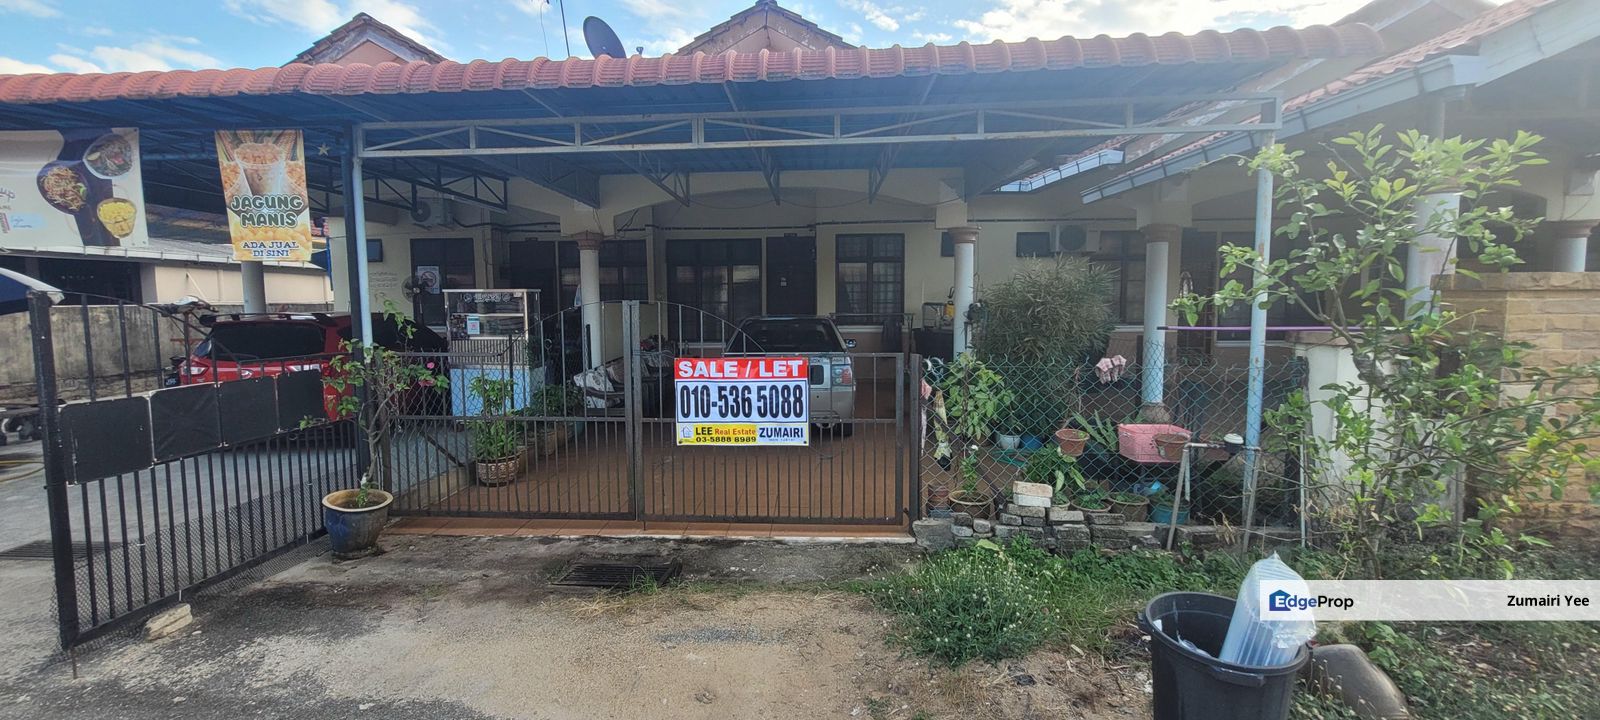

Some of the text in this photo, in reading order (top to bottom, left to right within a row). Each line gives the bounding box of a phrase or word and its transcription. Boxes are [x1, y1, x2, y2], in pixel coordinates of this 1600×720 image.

[231, 195, 303, 210] JAGUNG
[241, 212, 298, 228] MANIS
[678, 360, 803, 378] SALE / LET
[680, 384, 804, 419] 010-536 5088
[695, 427, 713, 436] LEE
[714, 428, 731, 436] Real
[759, 427, 803, 438] ZUMAIRI
